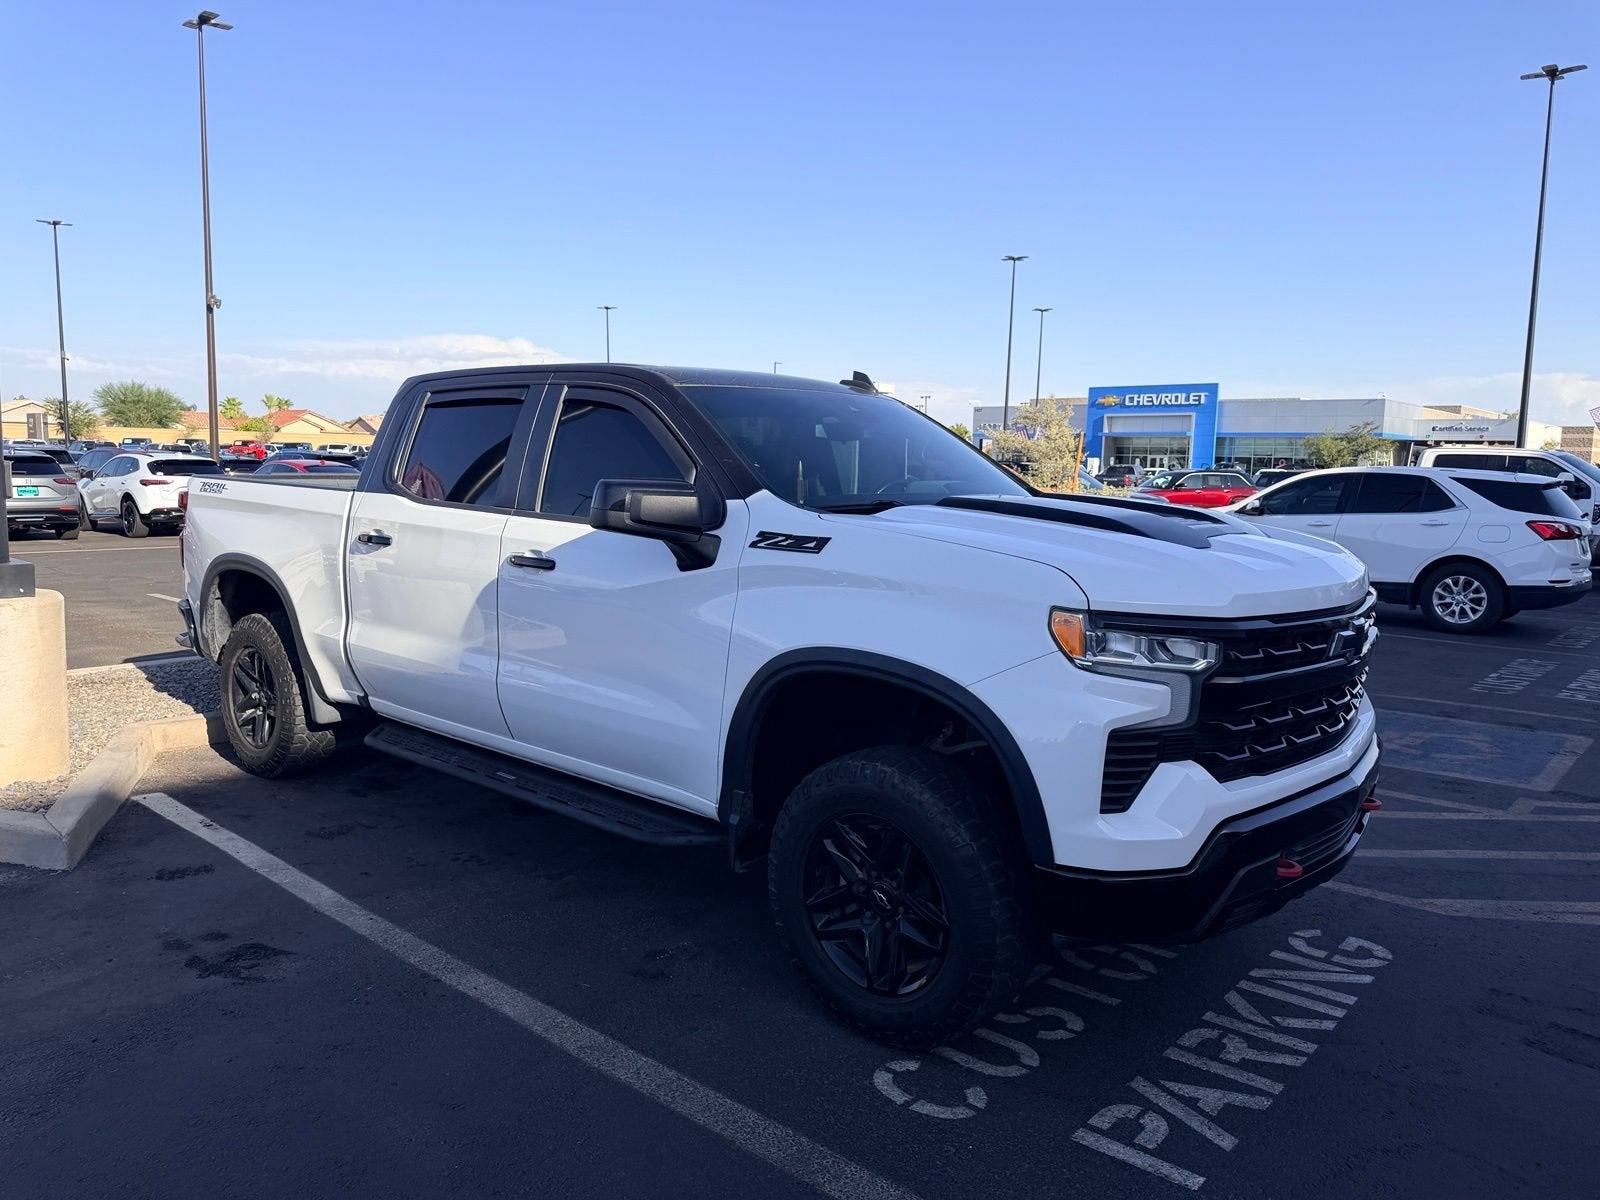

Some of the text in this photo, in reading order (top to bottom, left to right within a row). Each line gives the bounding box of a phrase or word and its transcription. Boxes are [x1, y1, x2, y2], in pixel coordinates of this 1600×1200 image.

[1125, 392, 1209, 406] CHEVROLET
[200, 481, 228, 490] TRAIL
[1070, 929, 1394, 1191] PARKING
